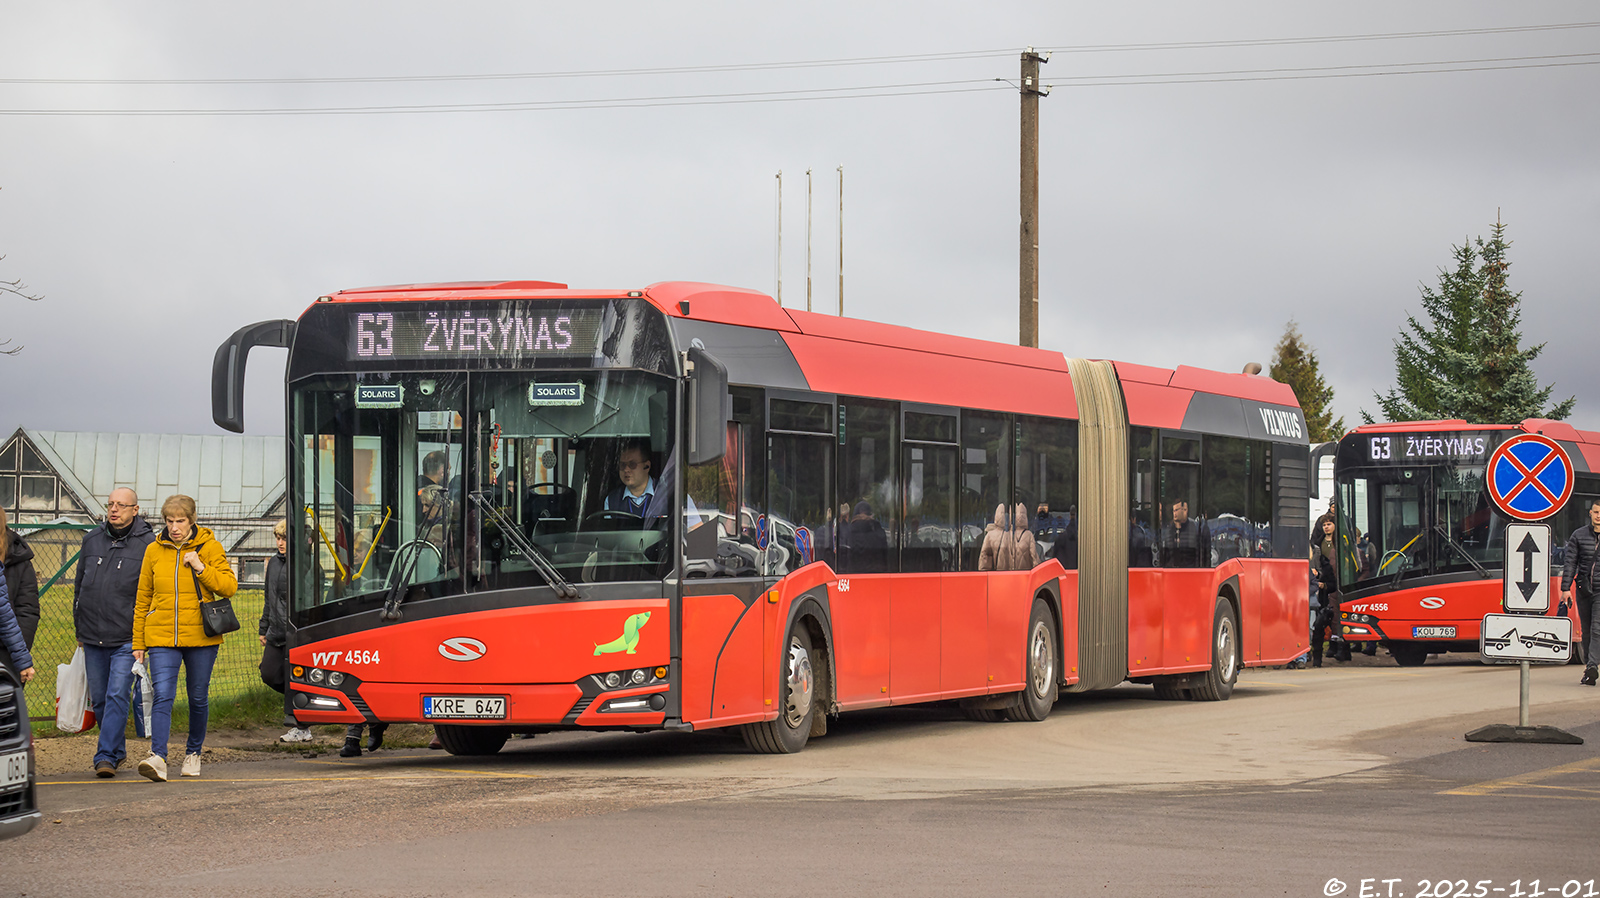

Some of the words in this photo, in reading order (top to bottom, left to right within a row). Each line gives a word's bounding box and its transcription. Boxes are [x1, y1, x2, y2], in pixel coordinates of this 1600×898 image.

[356, 312, 394, 357] 63
[423, 311, 573, 352] ŽVĖRYNAS
[361, 390, 397, 399] SOLARIS
[536, 387, 577, 397] SOLARIS
[1258, 407, 1302, 439] VILNIUS
[1371, 436, 1391, 460] 63
[1406, 435, 1485, 457] ŽVĖRYNAS
[837, 578, 850, 592] 4564
[1369, 603, 1389, 612] 4556
[1417, 628, 1436, 636] KOU
[1440, 628, 1456, 636] 769
[345, 650, 381, 665] 4564
[433, 699, 466, 714] KRE
[475, 699, 503, 714] 647
